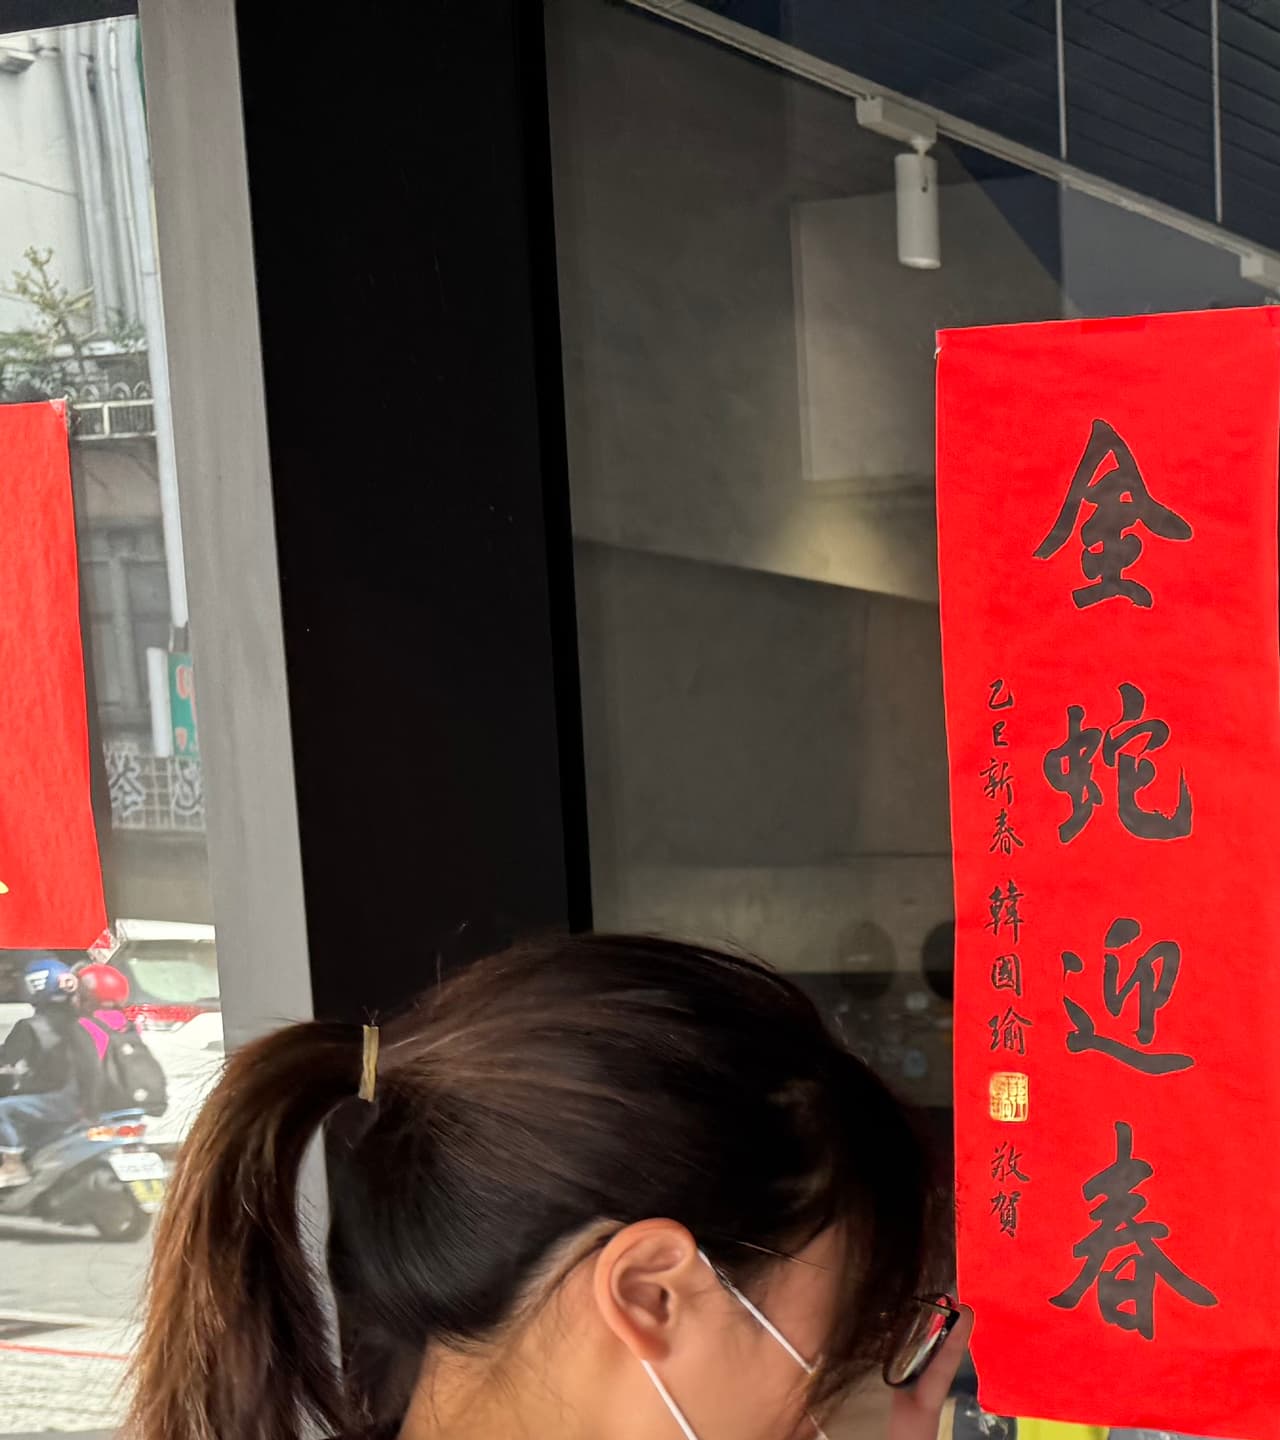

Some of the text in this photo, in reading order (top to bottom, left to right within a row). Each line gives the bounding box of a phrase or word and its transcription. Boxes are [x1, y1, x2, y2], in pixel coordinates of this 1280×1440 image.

[979, 679, 1024, 856] 乙巳新春
[986, 879, 1033, 1055] 韓國瑜
[1032, 419, 1218, 1341] 金蛇迎春
[990, 1141, 1031, 1239] 敬賀
